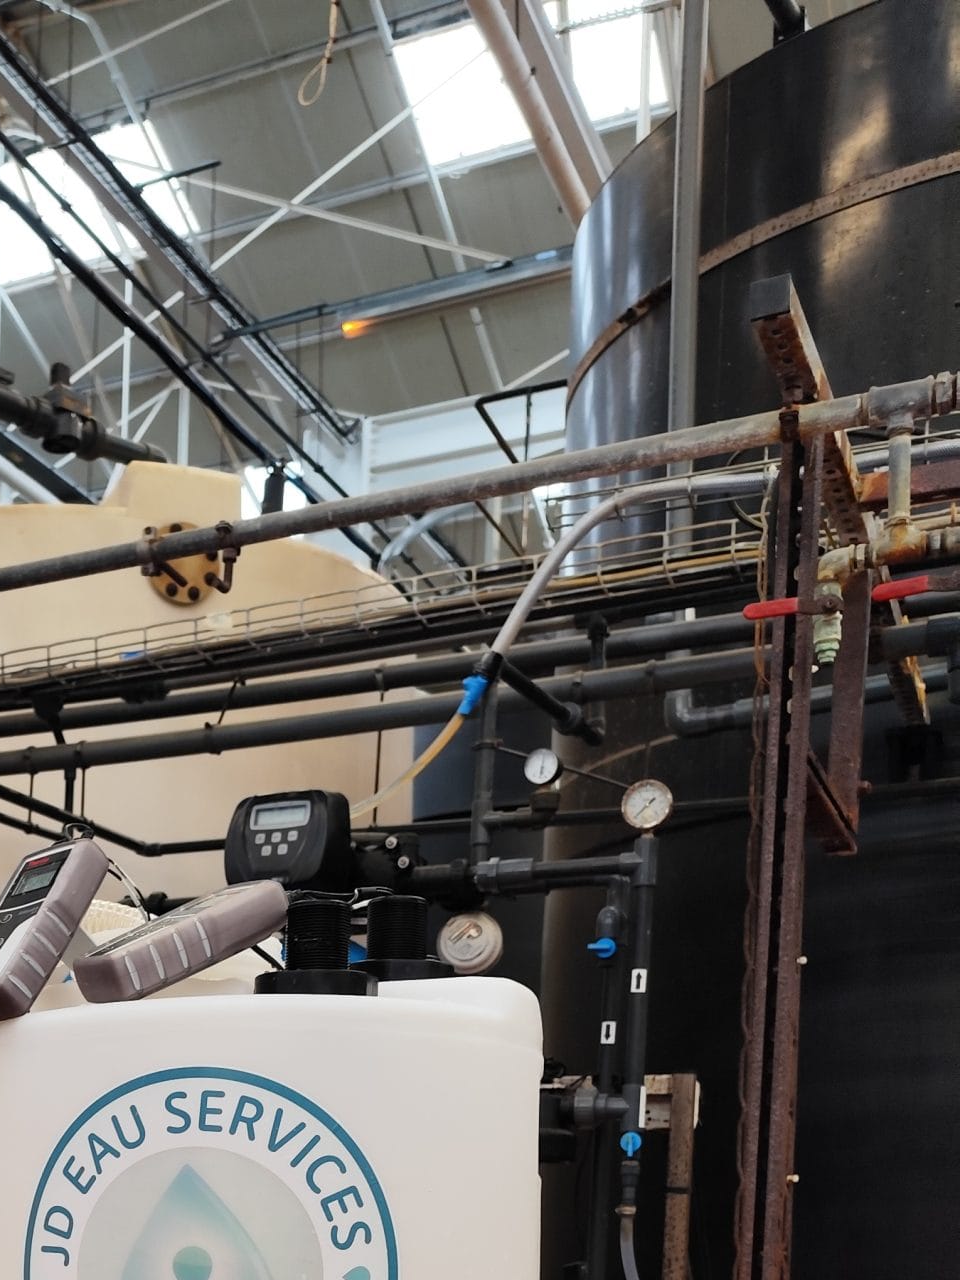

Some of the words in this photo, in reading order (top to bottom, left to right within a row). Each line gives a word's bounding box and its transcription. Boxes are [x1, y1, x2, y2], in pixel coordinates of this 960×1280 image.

[39, 1204, 75, 1268] JD
[61, 1103, 147, 1195] EAU
[164, 1089, 372, 1251] SERVICES
